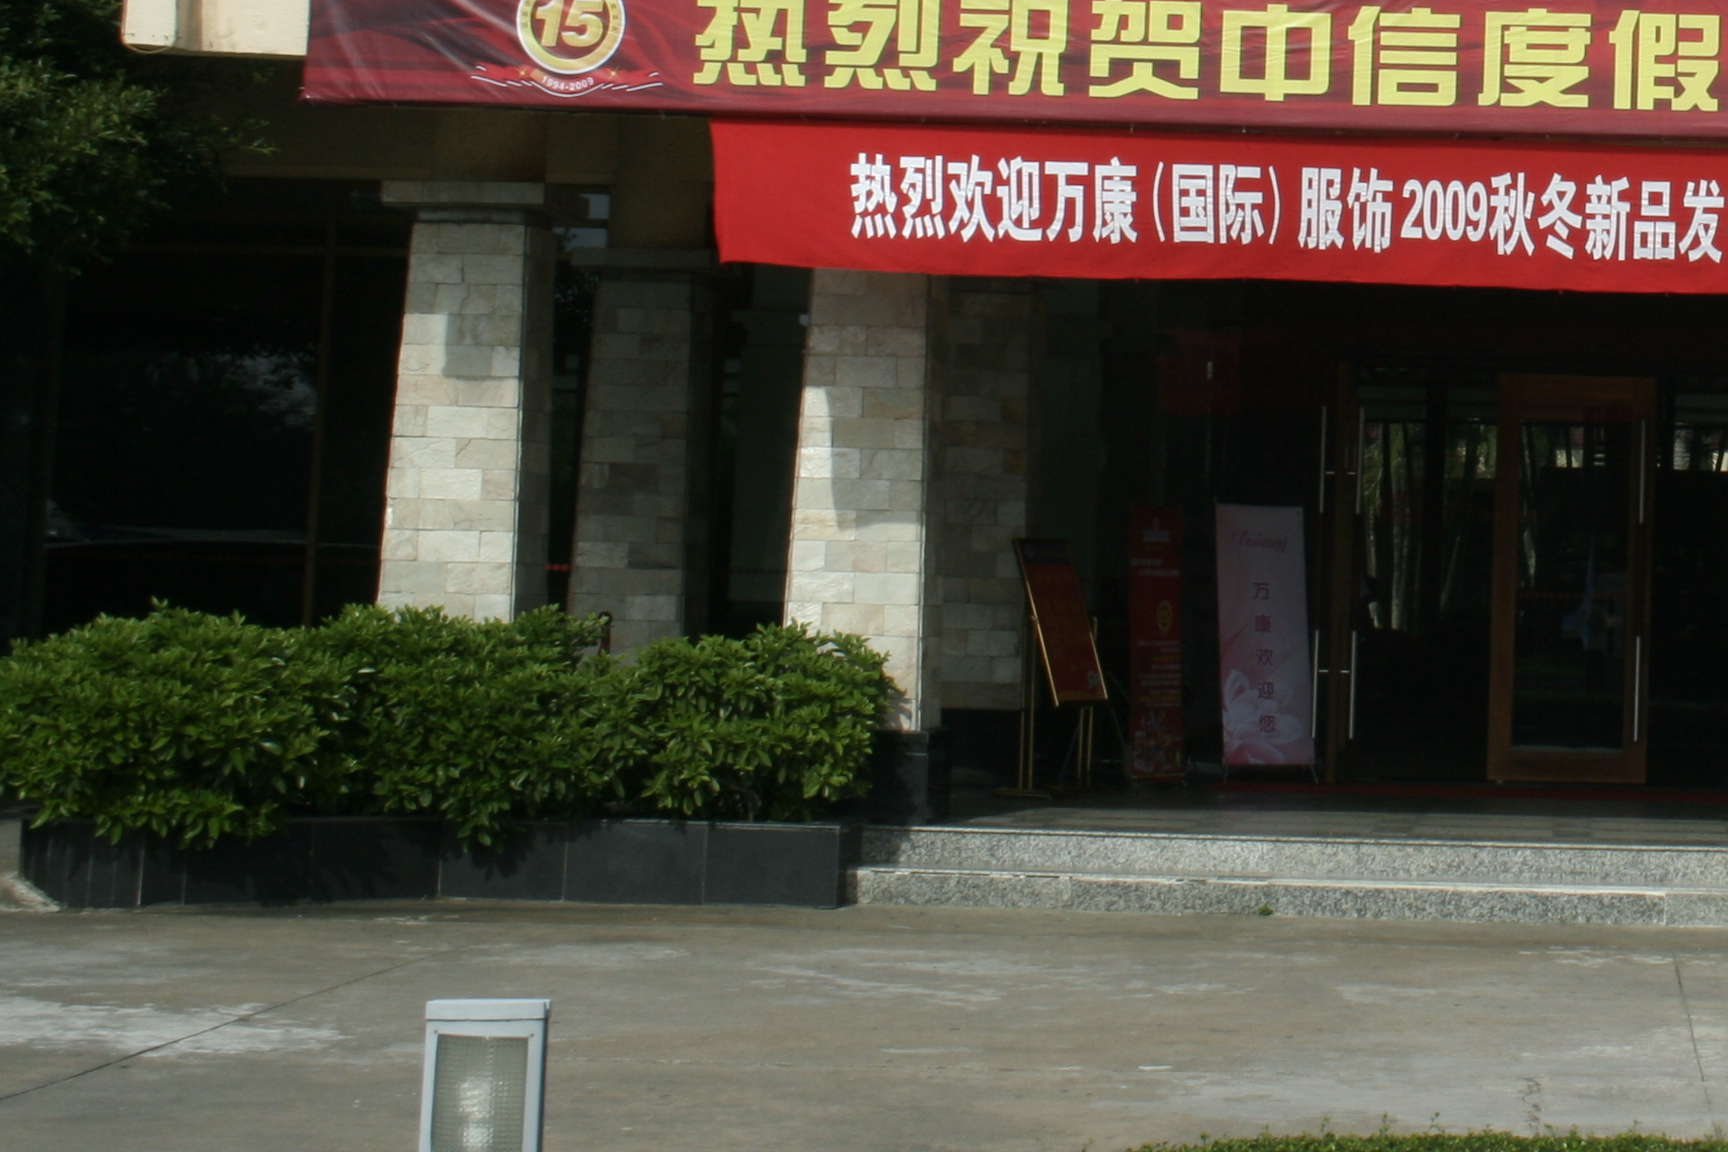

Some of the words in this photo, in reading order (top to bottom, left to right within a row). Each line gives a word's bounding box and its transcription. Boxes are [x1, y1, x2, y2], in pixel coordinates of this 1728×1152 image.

[541, 76, 595, 92] 1994-2009
[1252, 582, 1277, 734] 万康欢迎您
